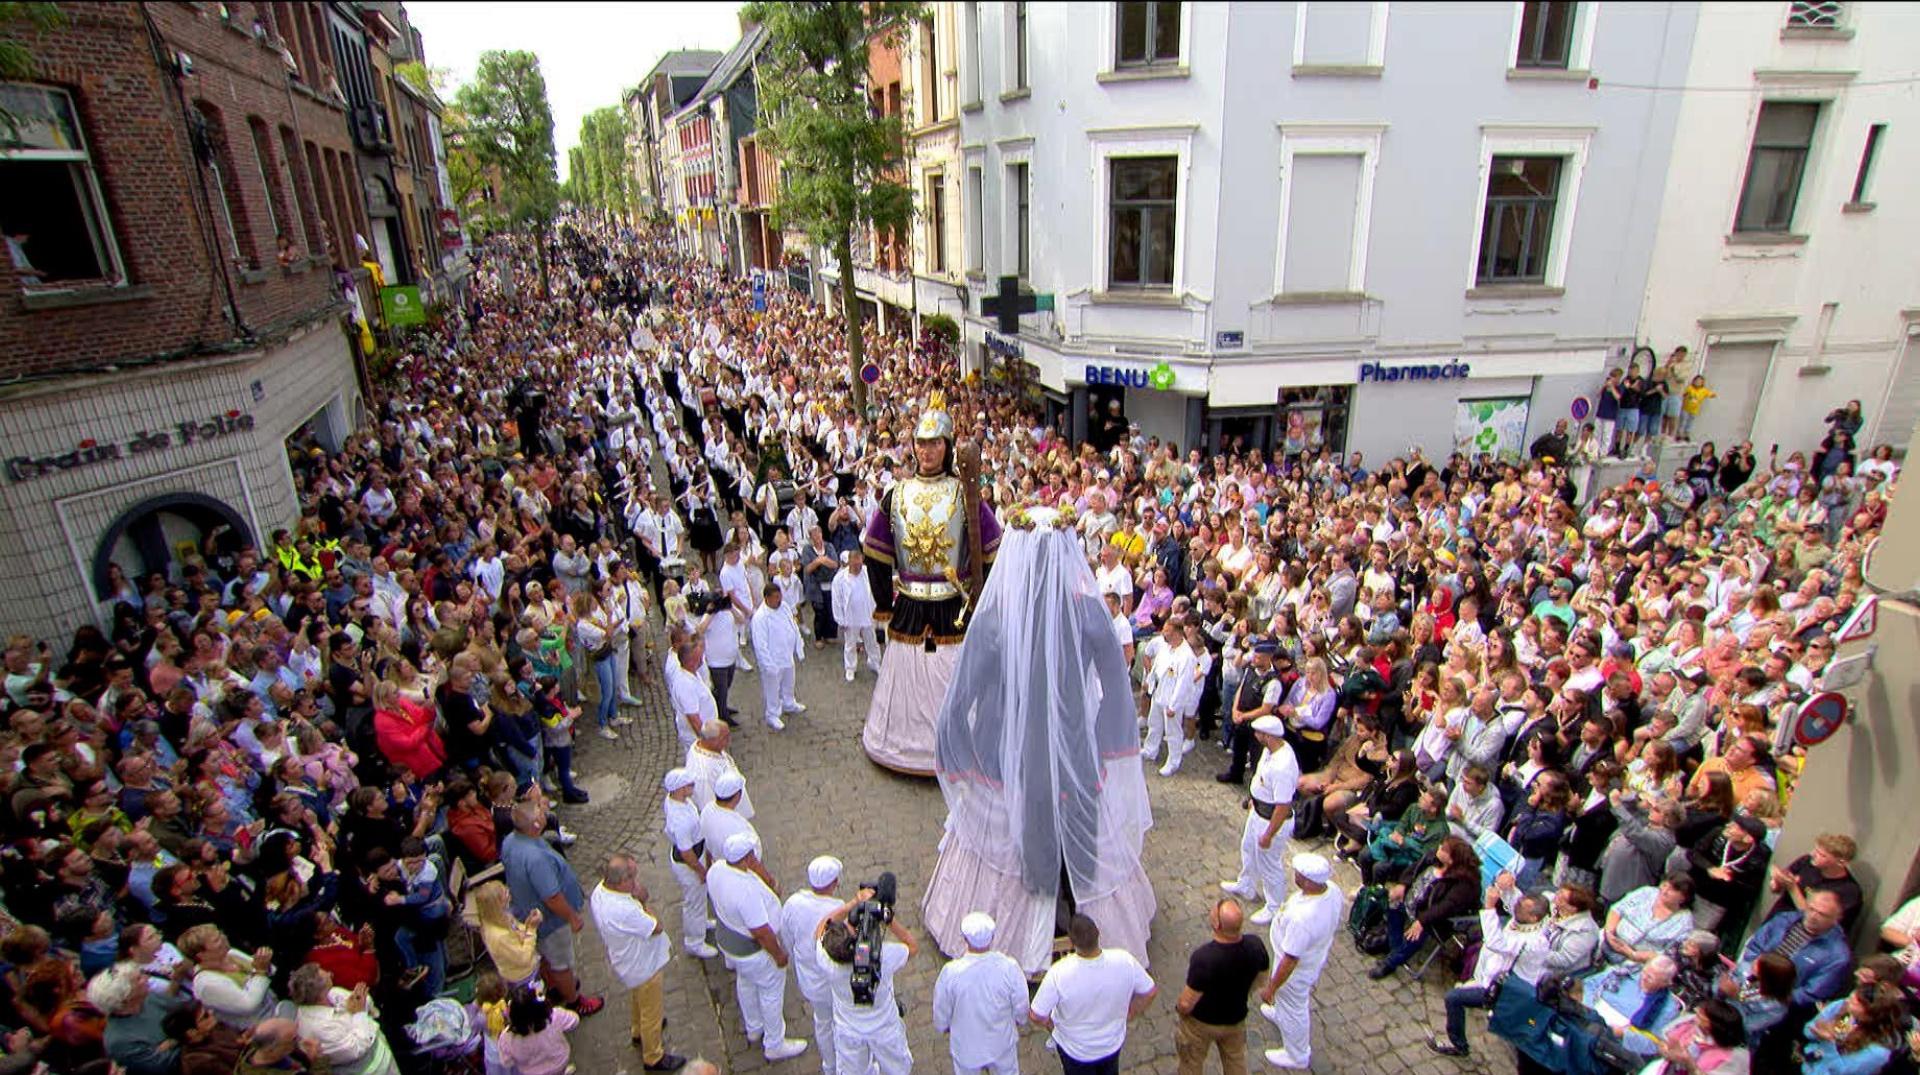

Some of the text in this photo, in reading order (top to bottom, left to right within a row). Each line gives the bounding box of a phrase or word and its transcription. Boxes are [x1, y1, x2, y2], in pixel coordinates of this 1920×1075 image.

[1086, 365, 1148, 388] BENU
[1361, 358, 1470, 381] Pharmacie
[130, 431, 170, 451] de
